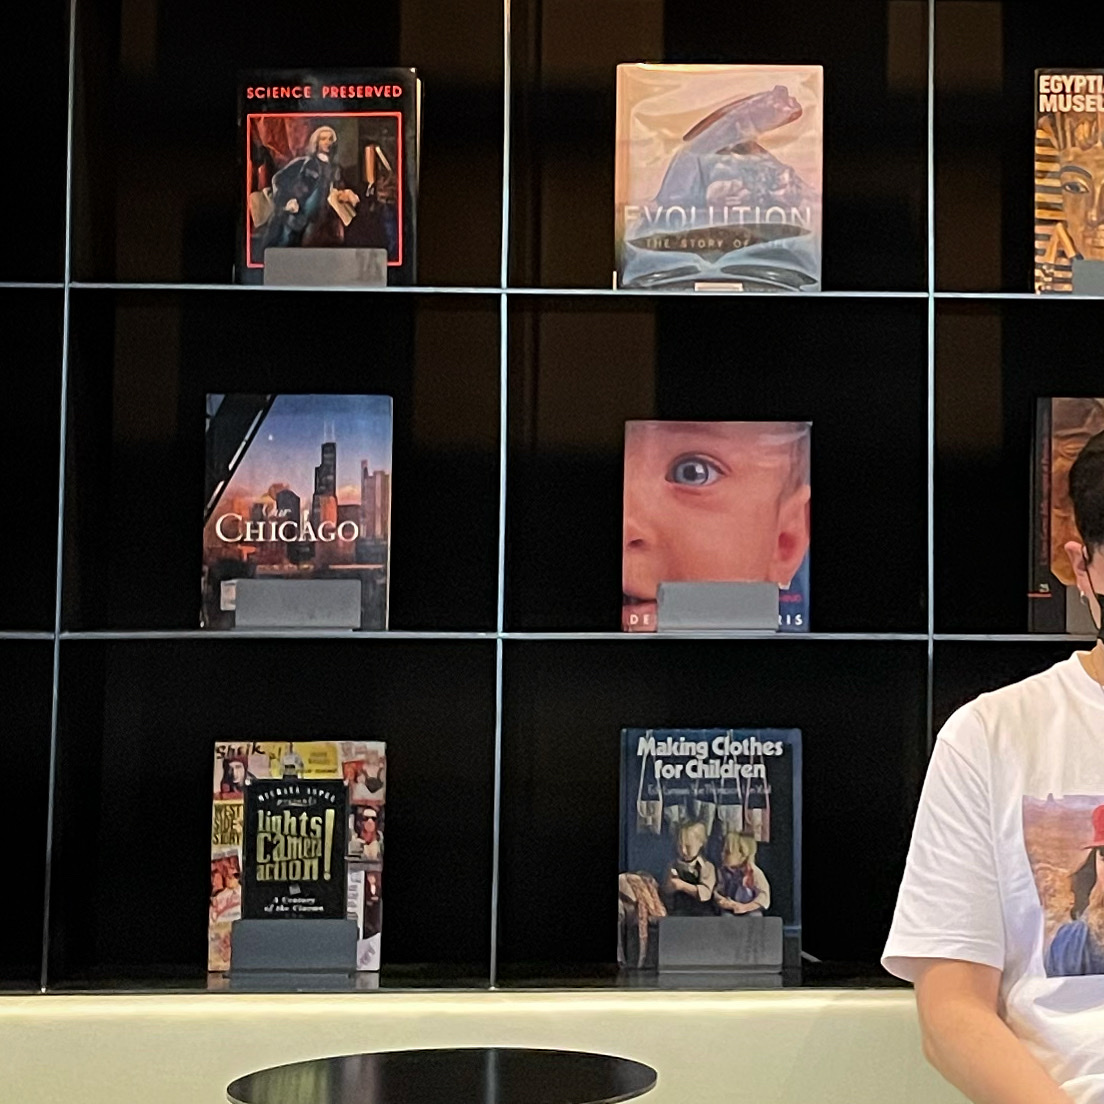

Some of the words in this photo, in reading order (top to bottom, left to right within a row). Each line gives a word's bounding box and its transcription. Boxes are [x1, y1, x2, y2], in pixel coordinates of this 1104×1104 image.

[247, 86, 311, 99] SCIENCE
[322, 85, 403, 99] PRESERVED
[624, 205, 811, 227] EVOLUTION
[646, 239, 670, 249] THE
[680, 239, 724, 249] STORY
[637, 736, 709, 759] Making
[711, 735, 784, 756] Clothes
[655, 759, 683, 779] for
[685, 759, 767, 779] Children
